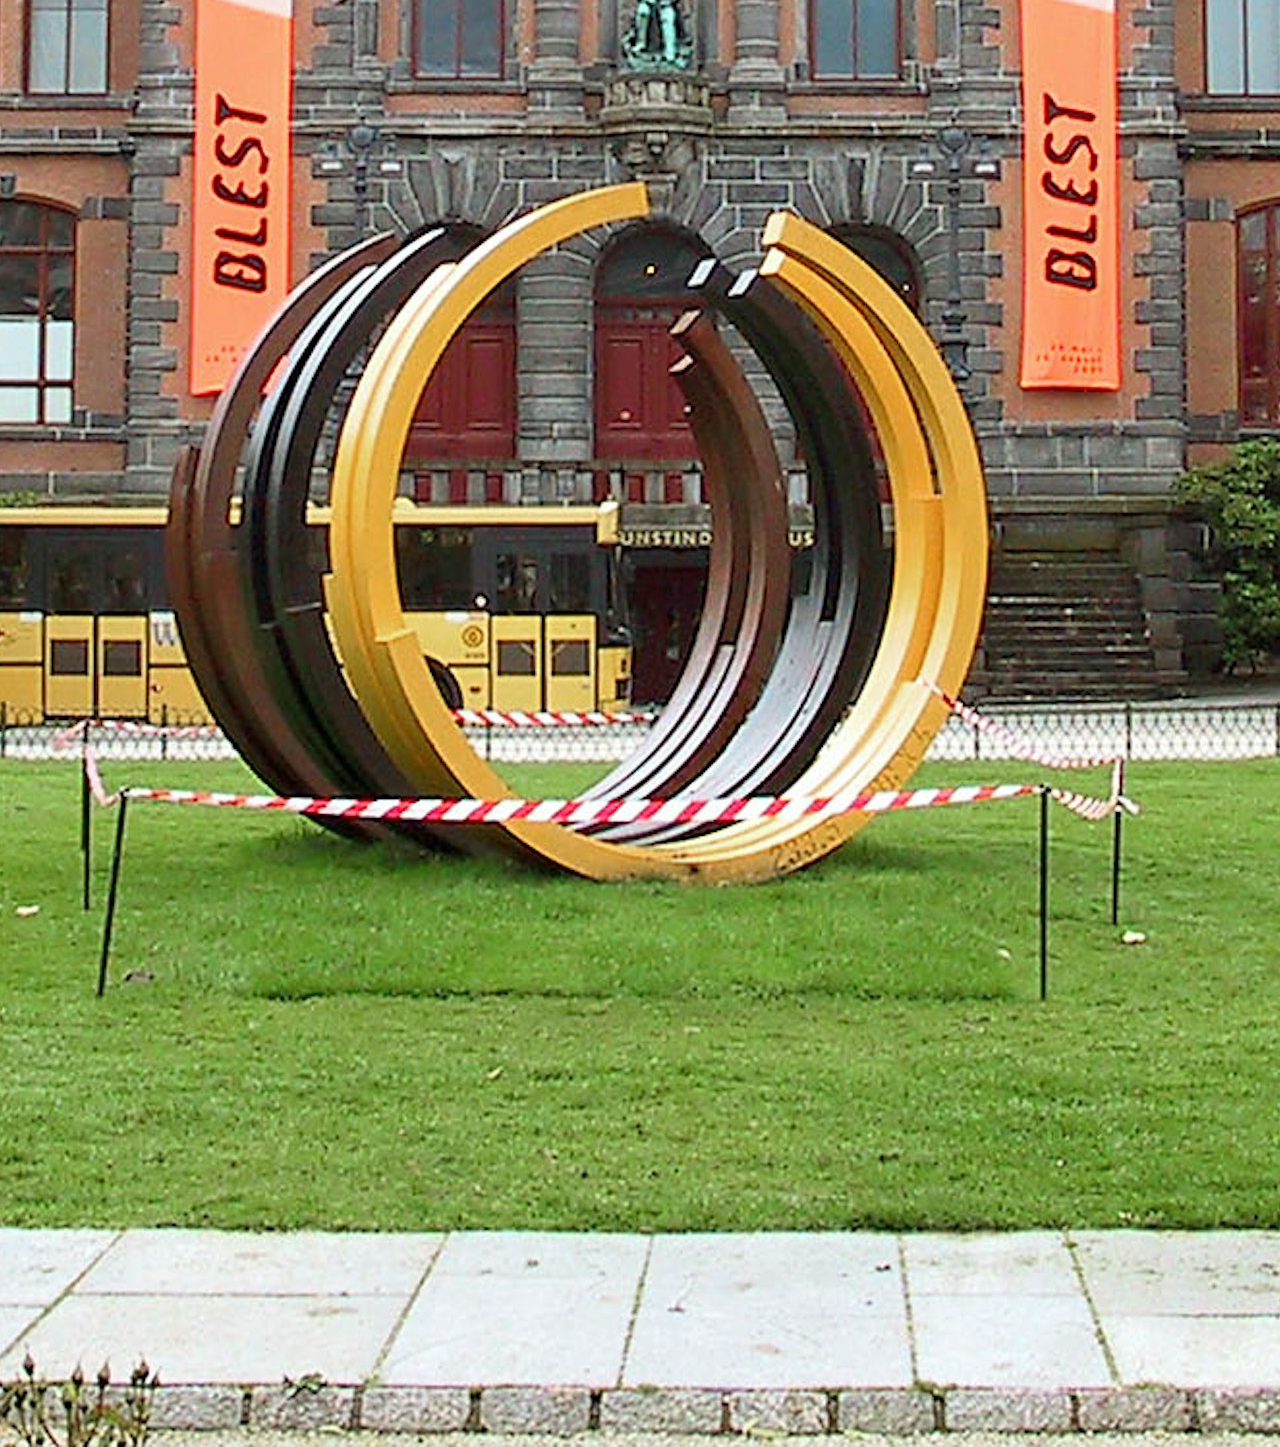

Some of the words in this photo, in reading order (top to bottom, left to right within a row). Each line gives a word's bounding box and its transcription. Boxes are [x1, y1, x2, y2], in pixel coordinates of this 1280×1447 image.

[212, 94, 269, 292] BLEST
[1042, 92, 1098, 291] BLEST
[618, 530, 713, 547] UNSTIND
[788, 530, 815, 547] US
